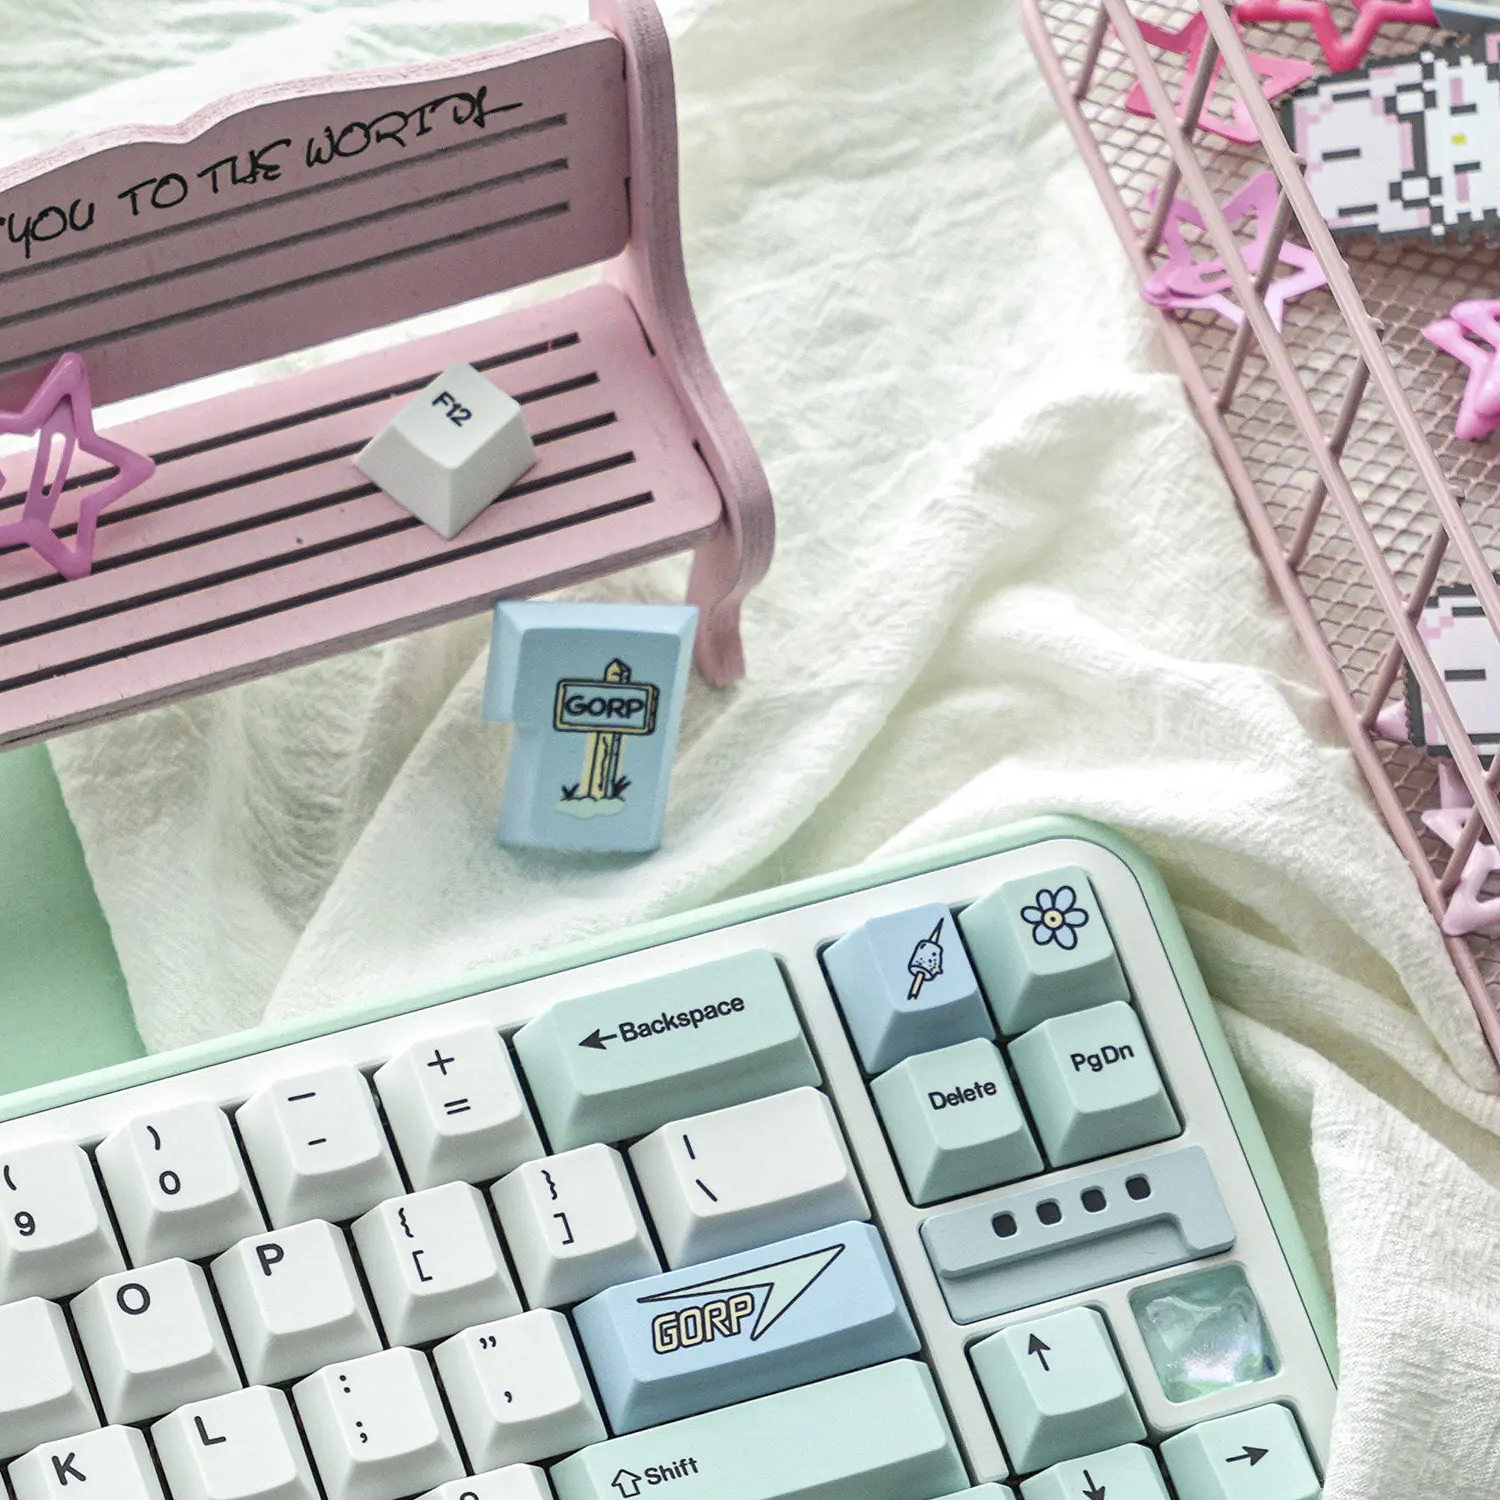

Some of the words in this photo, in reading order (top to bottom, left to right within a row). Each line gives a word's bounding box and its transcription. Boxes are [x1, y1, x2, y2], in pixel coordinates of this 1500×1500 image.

[117, 172, 189, 216] TO
[197, 137, 293, 187] THE
[432, 391, 472, 427] F12
[563, 694, 646, 720] GORP
[618, 997, 745, 1043] Backspace
[427, 1049, 455, 1076] +
[1070, 1045, 1135, 1073] PgDn
[443, 1098, 471, 1115] =
[927, 1081, 997, 1111] Delete
[146, 1125, 161, 1151] )
[3, 1164, 17, 1191] (
[540, 1169, 558, 1201] }
[14, 1211, 36, 1237] 9
[398, 1207, 414, 1238] {
[553, 1212, 575, 1245] ]
[255, 1243, 285, 1277] P
[411, 1249, 433, 1282] [
[116, 1282, 151, 1316] O
[651, 1293, 754, 1354] GORP
[194, 1415, 227, 1446] L
[51, 1452, 87, 1486] K
[644, 1457, 699, 1486] Shift
